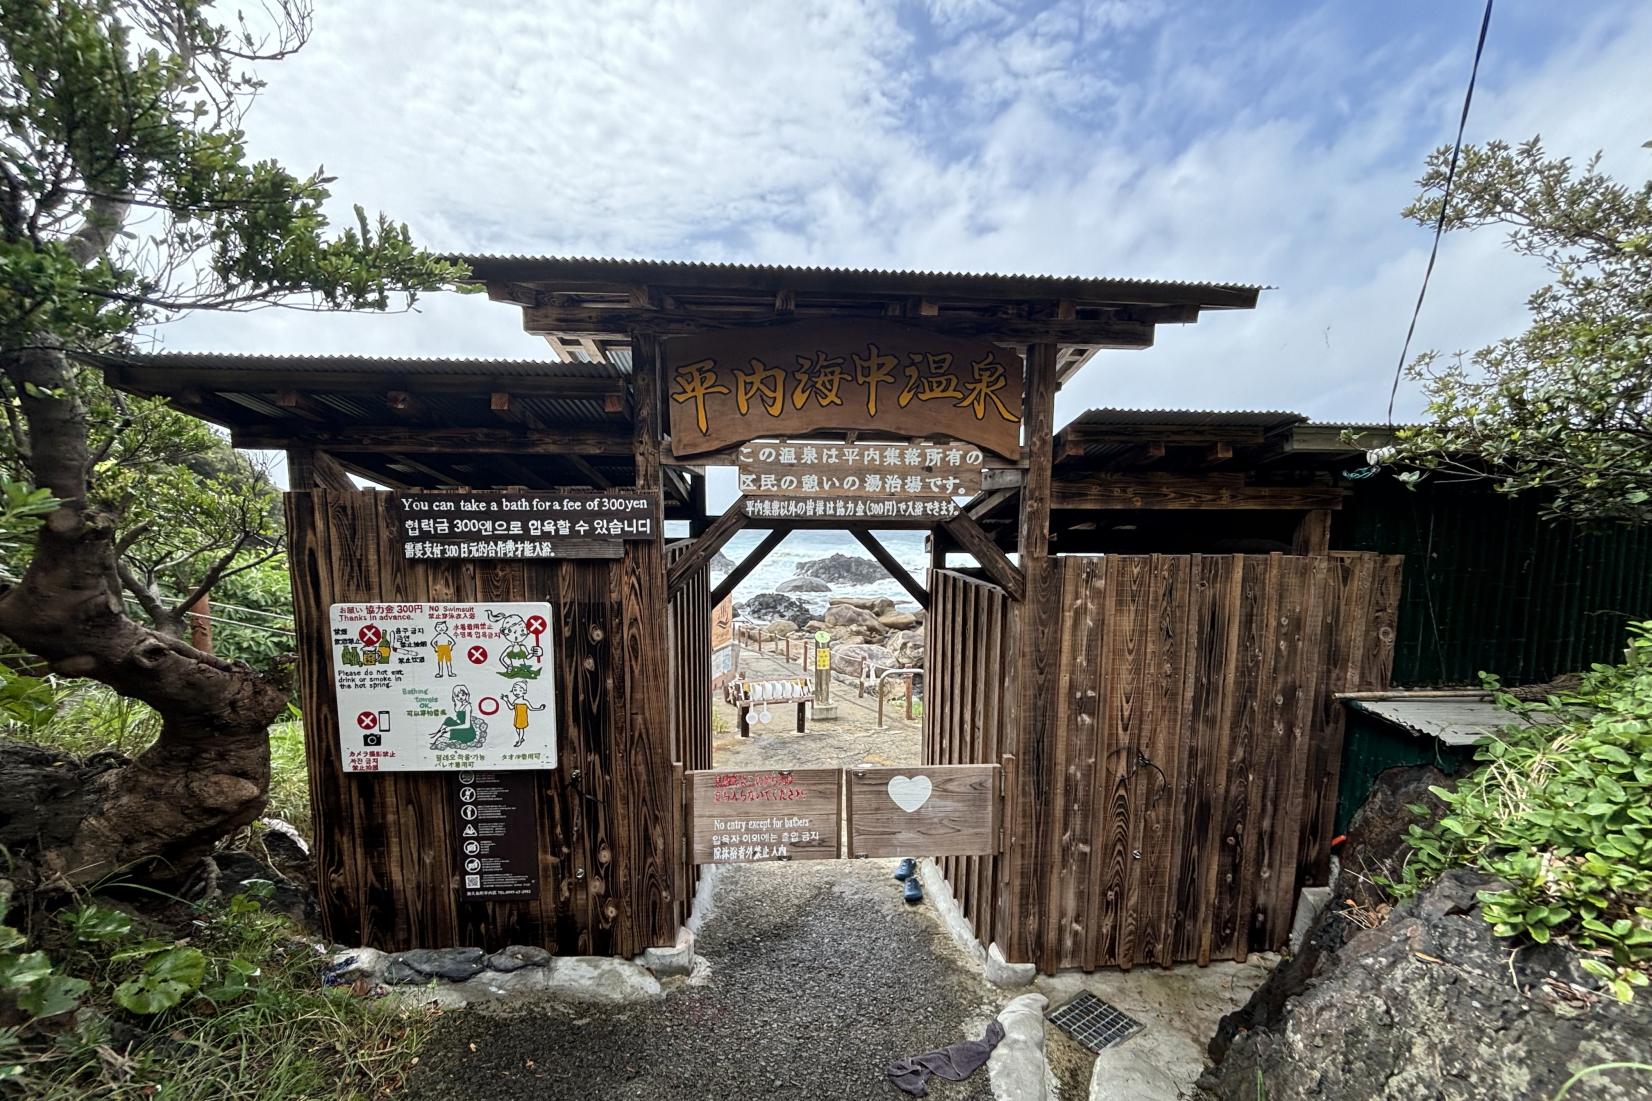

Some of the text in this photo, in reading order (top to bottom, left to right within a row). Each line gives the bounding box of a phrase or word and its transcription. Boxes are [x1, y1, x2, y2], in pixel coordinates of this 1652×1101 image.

[671, 344, 1021, 435] 平内海中温泉
[740, 445, 983, 466] この温泉は平内集落所有の
[740, 474, 966, 494] 区民の憩いの湯治場です。
[401, 499, 429, 511] You
[433, 501, 455, 511] can
[460, 499, 487, 511] take
[490, 501, 499, 511] a
[502, 498, 530, 511] bath
[532, 499, 551, 511] for
[552, 501, 561, 511] a
[563, 498, 582, 511] fee
[586, 498, 600, 511] of
[405, 519, 450, 536] 협력금
[453, 519, 524, 536] 300엔으로
[528, 519, 571, 536] 입욕할
[574, 520, 590, 536] 수
[365, 605, 394, 614] 協力金
[396, 604, 423, 614] 300円
[429, 605, 475, 613] NO Swimsuit
[339, 614, 367, 622] Thanks
[364, 668, 374, 676] do
[369, 675, 391, 683] smoke
[394, 674, 402, 682] in
[340, 682, 351, 690] the
[714, 816, 810, 832] No entry except for bathers
